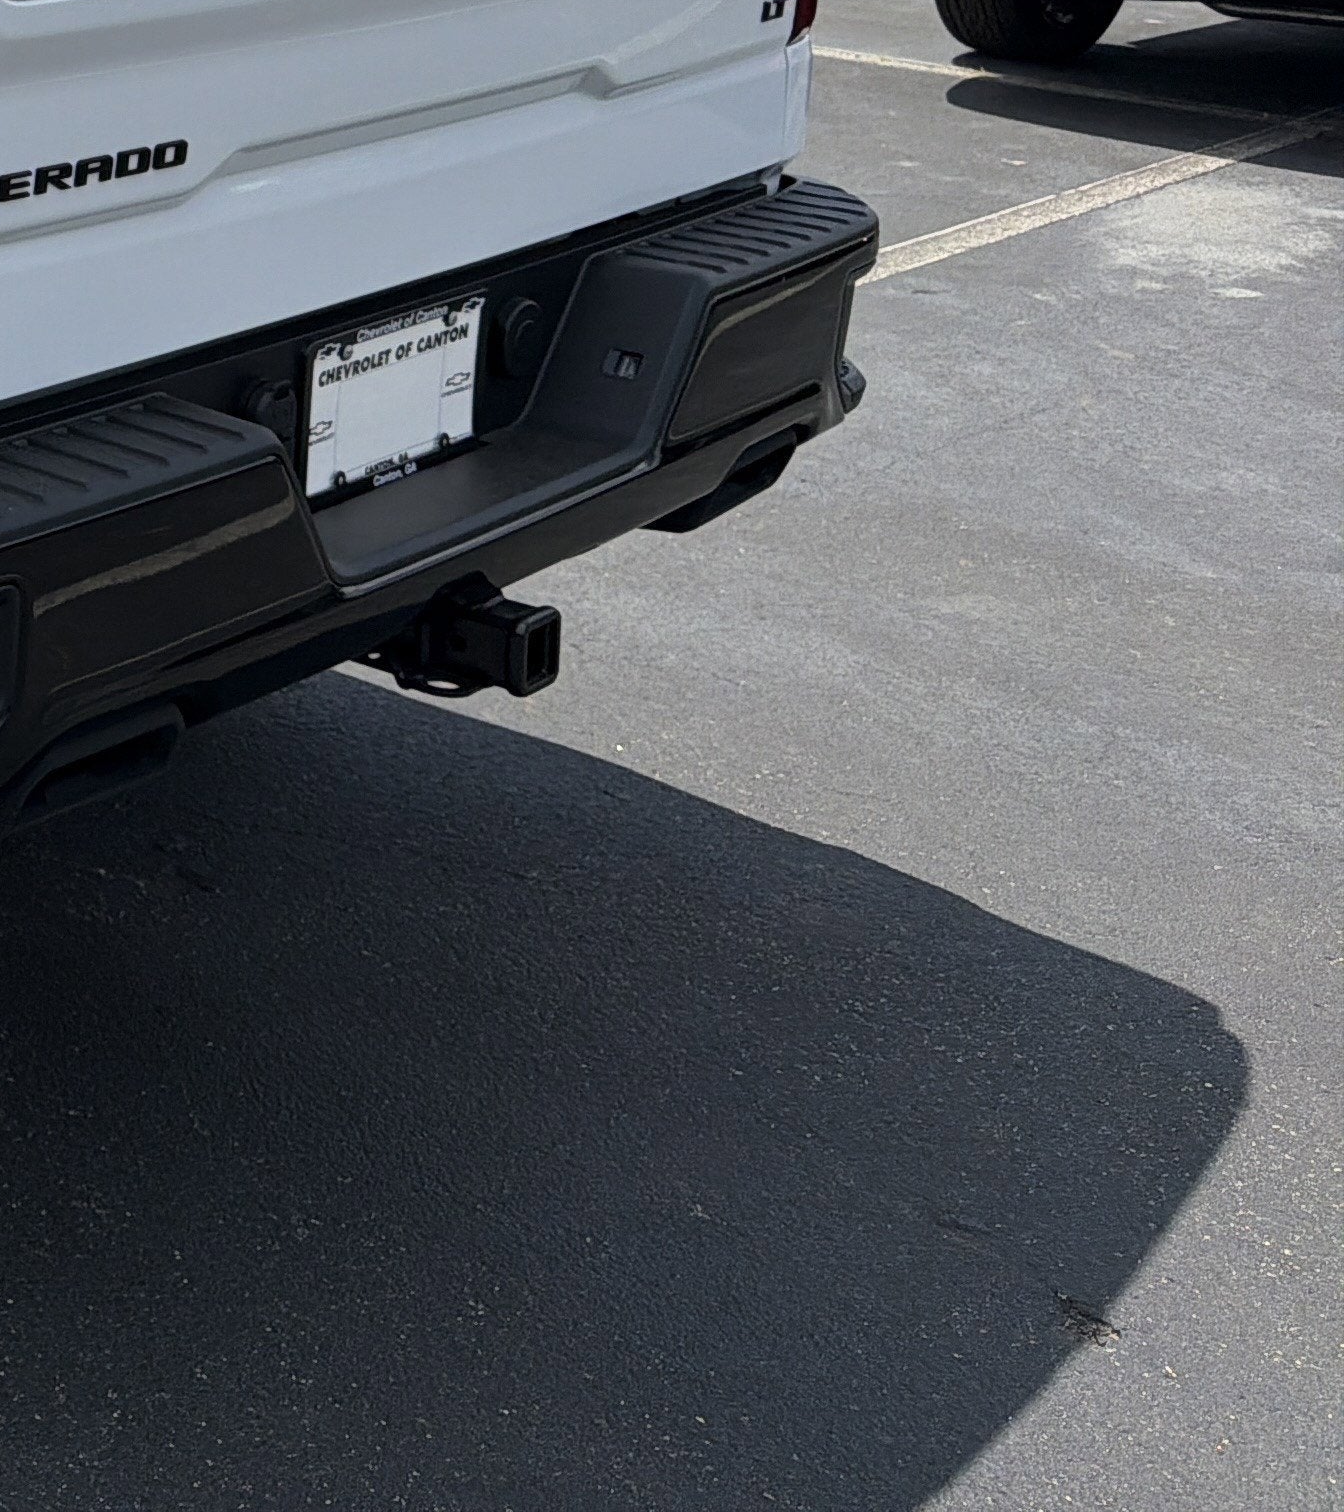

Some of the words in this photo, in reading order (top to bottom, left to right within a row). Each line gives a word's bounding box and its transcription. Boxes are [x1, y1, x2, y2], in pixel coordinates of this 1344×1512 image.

[318, 347, 392, 388] CHEVROLET
[395, 340, 413, 361] OF
[416, 322, 470, 354] CANTON
